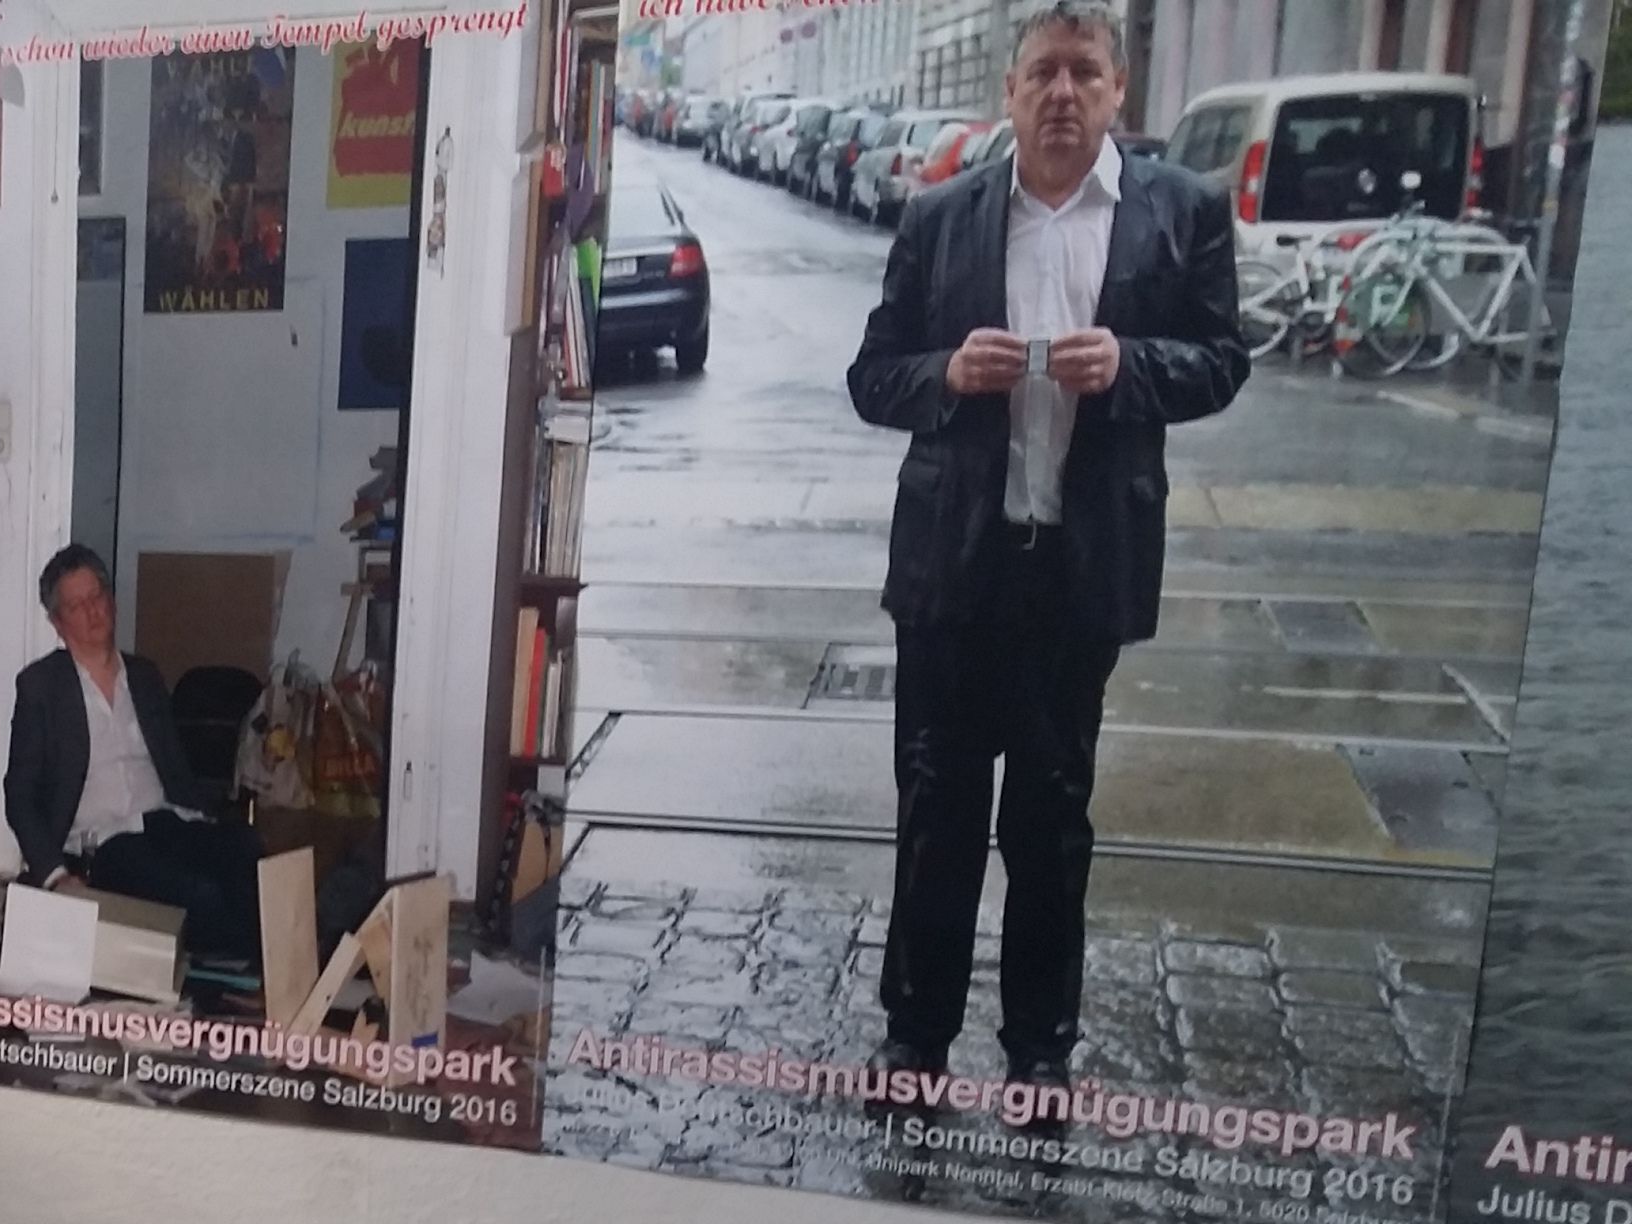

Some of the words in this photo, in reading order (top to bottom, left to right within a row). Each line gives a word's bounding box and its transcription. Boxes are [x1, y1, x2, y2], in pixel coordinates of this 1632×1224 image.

[1, 35, 77, 66] schon
[82, 23, 175, 61] wieder
[180, 23, 255, 55] einen
[260, 10, 369, 55] Tempel
[376, 2, 530, 50] gesprengt
[159, 285, 269, 312] WÄHLEN
[136, 1055, 316, 1103] Sommerszene
[323, 1078, 442, 1122] Salzburg
[449, 1093, 517, 1127] 2016
[567, 1027, 1417, 1160] Antirassismusvergnügungspark
[901, 1117, 1144, 1173] Sommerszene
[1154, 1145, 1313, 1200] Salzburg
[1323, 1166, 1415, 1206] 2016
